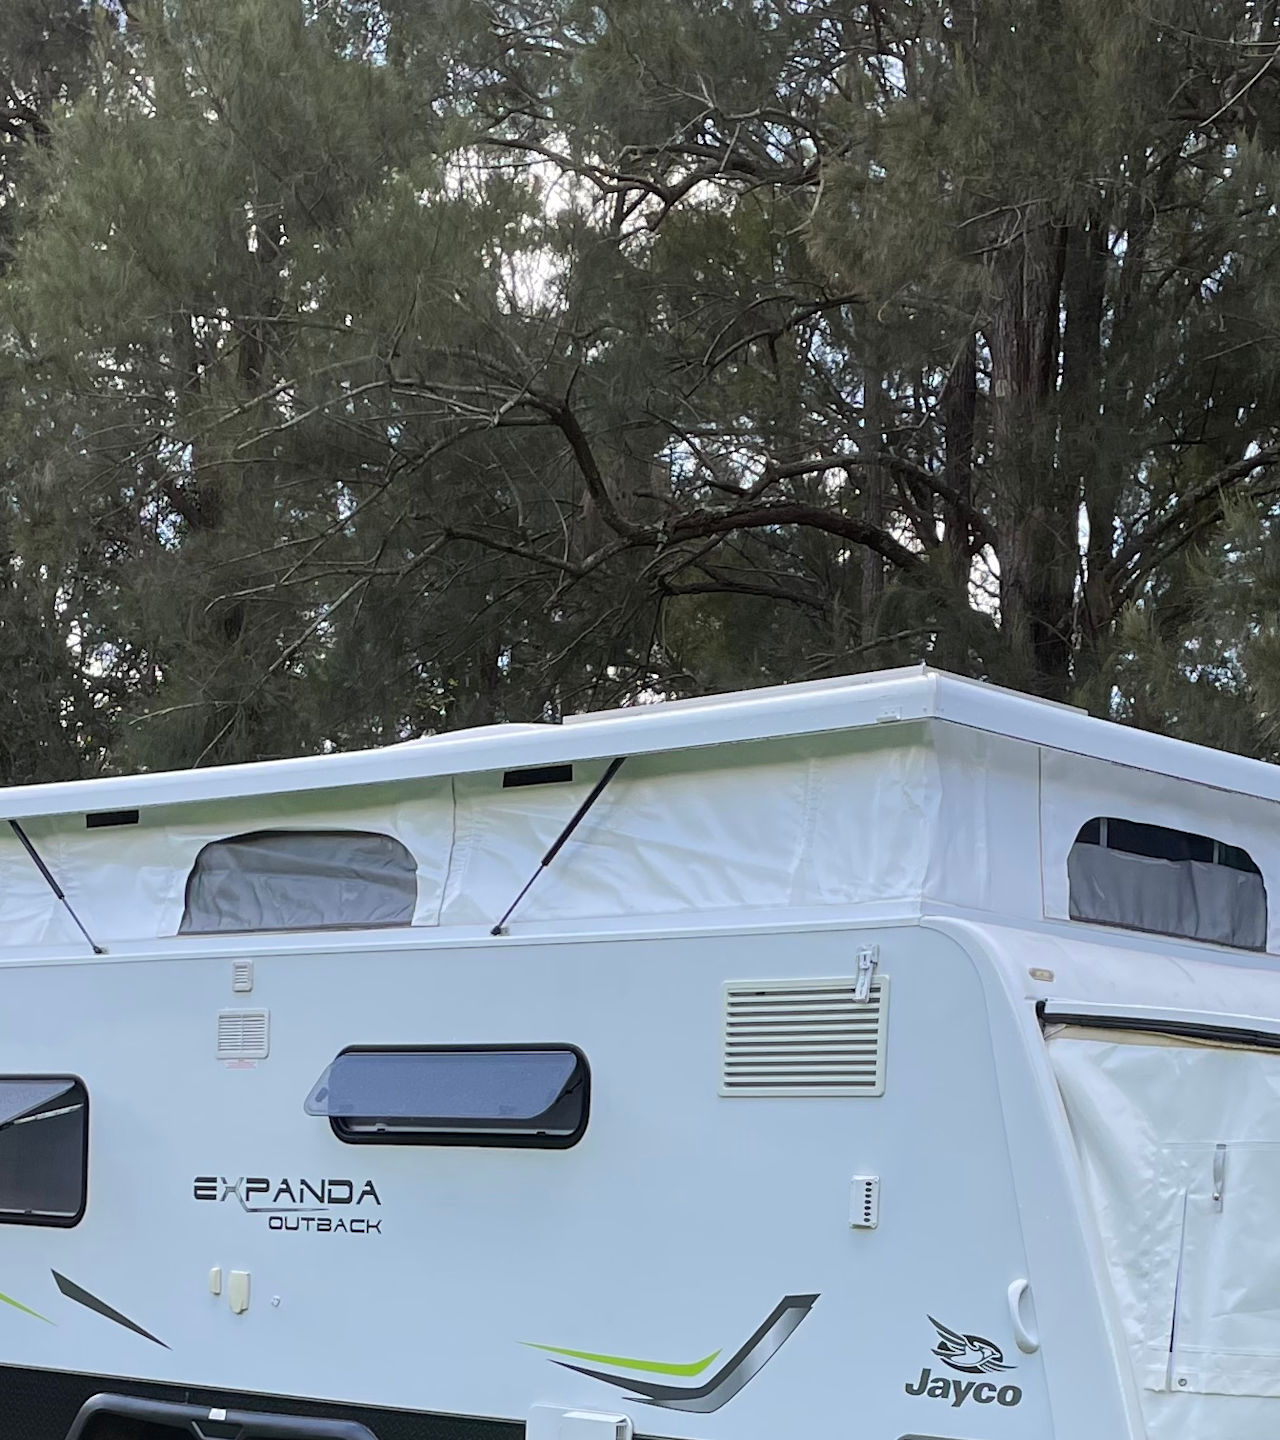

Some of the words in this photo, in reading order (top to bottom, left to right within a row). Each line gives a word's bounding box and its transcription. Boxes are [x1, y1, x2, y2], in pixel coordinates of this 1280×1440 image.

[194, 1176, 382, 1206] EXPANDA
[269, 1216, 382, 1234] OUTBACK
[905, 1367, 1023, 1408] Jayco
